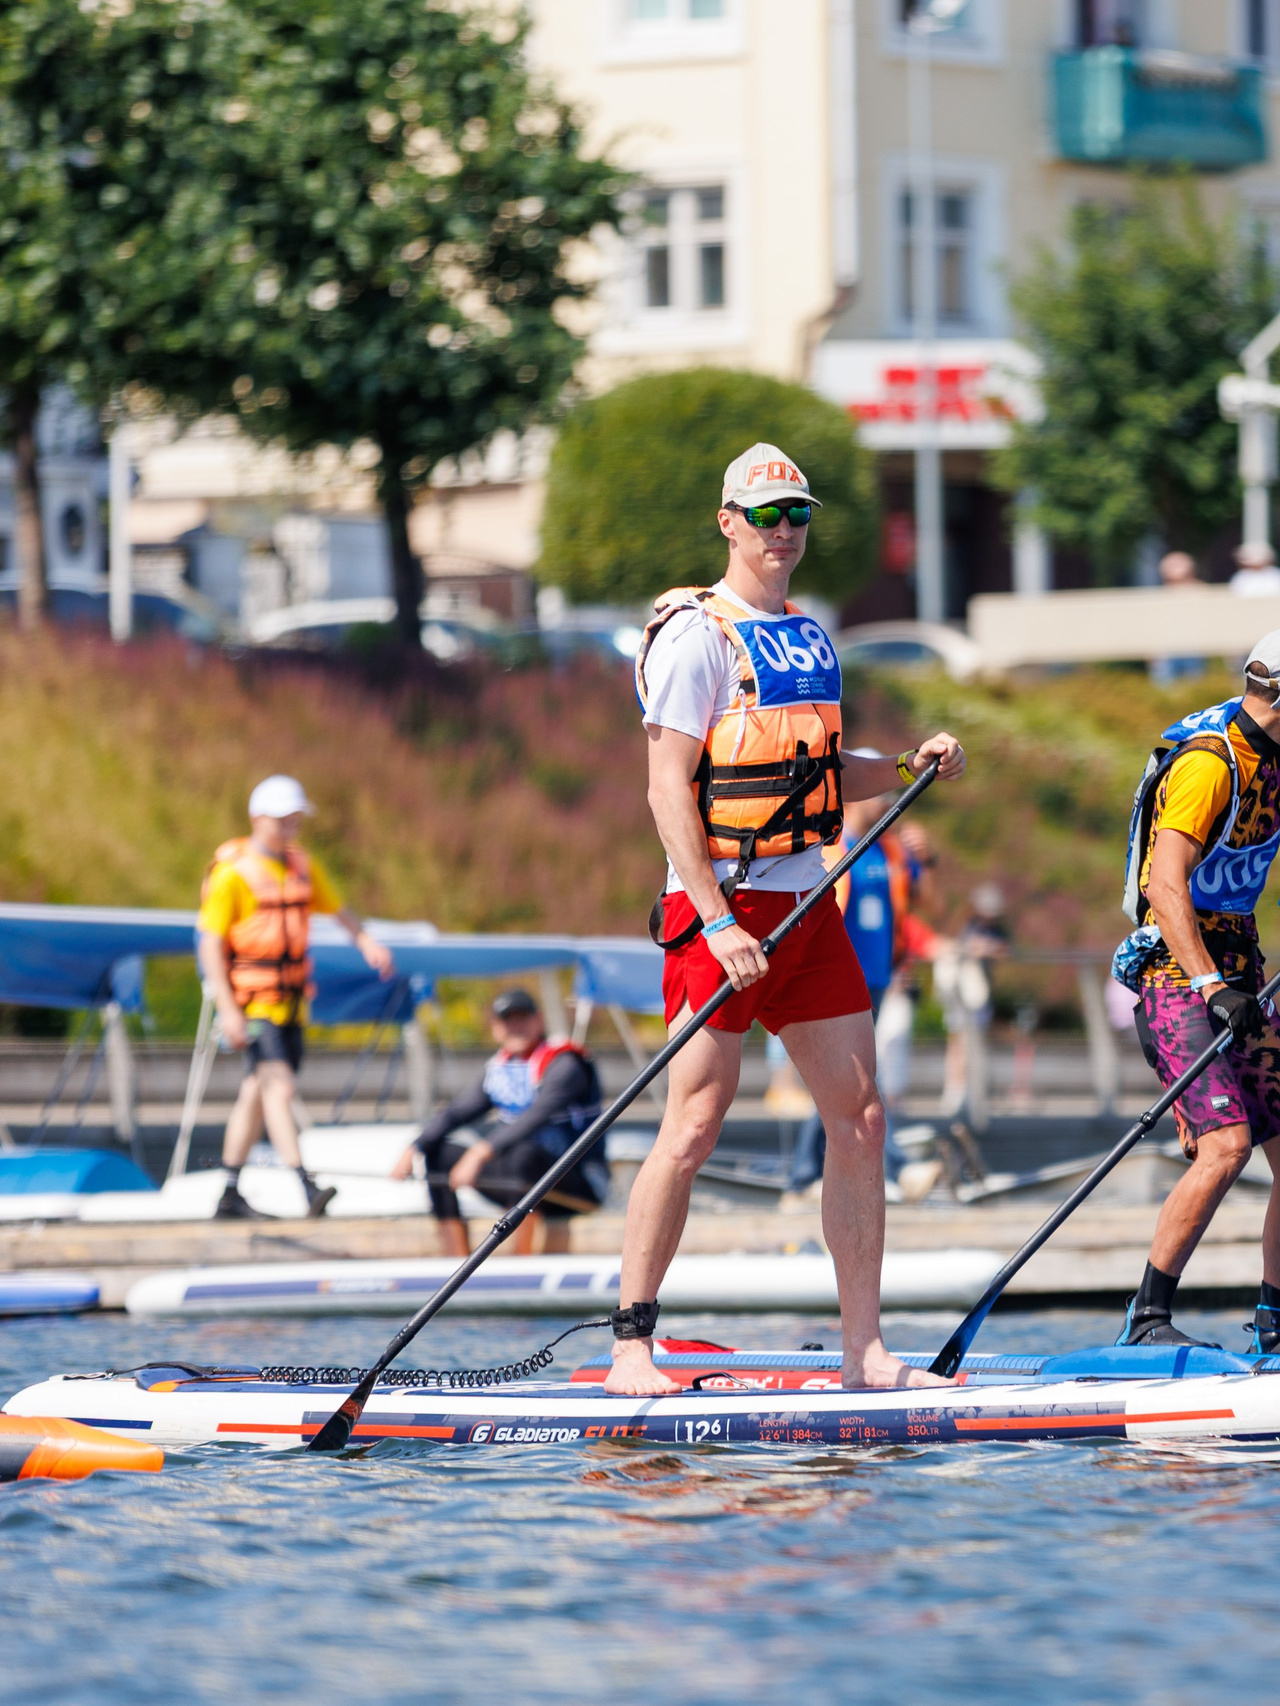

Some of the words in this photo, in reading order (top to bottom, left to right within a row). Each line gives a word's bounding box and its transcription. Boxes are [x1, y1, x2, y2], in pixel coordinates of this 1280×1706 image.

[747, 461, 803, 486] FOX
[753, 621, 835, 673] 068
[759, 1419, 789, 1428] LENGTH
[839, 1417, 865, 1426] WIDTH
[907, 1414, 940, 1423] VOLUME
[494, 1426, 580, 1442] GLADIATOR
